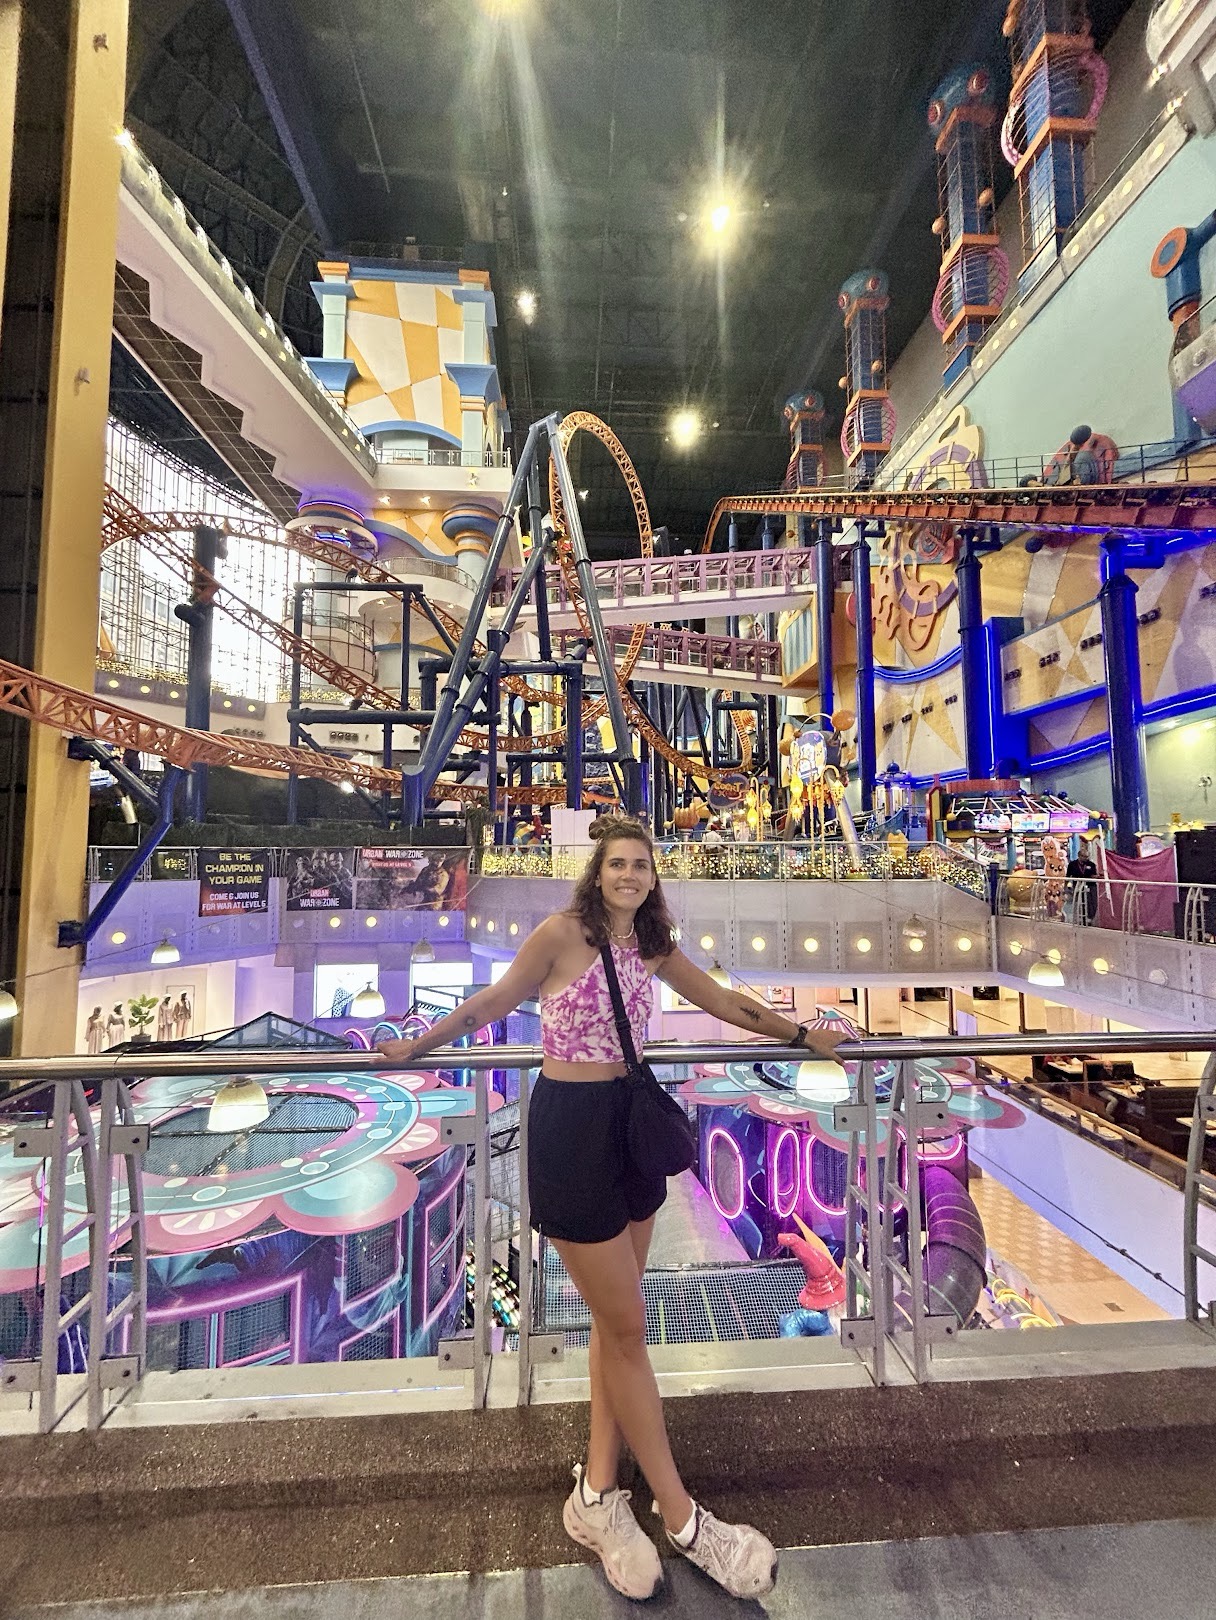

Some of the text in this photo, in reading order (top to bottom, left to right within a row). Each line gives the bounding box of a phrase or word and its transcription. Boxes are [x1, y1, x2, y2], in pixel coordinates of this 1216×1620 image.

[219, 853, 251, 861] BE THE
[362, 849, 424, 858] URBAN WAR ZONE
[205, 864, 264, 873] CHAMPION IN
[209, 876, 262, 885] YOUR GAME
[209, 893, 228, 901] COME
[234, 892, 250, 900] JOIN
[310, 889, 329, 897] URBAN
[202, 903, 216, 911] FOR
[217, 902, 233, 910] WAR
[242, 901, 260, 909] LEVEL
[300, 898, 340, 907] WAR ZONE
